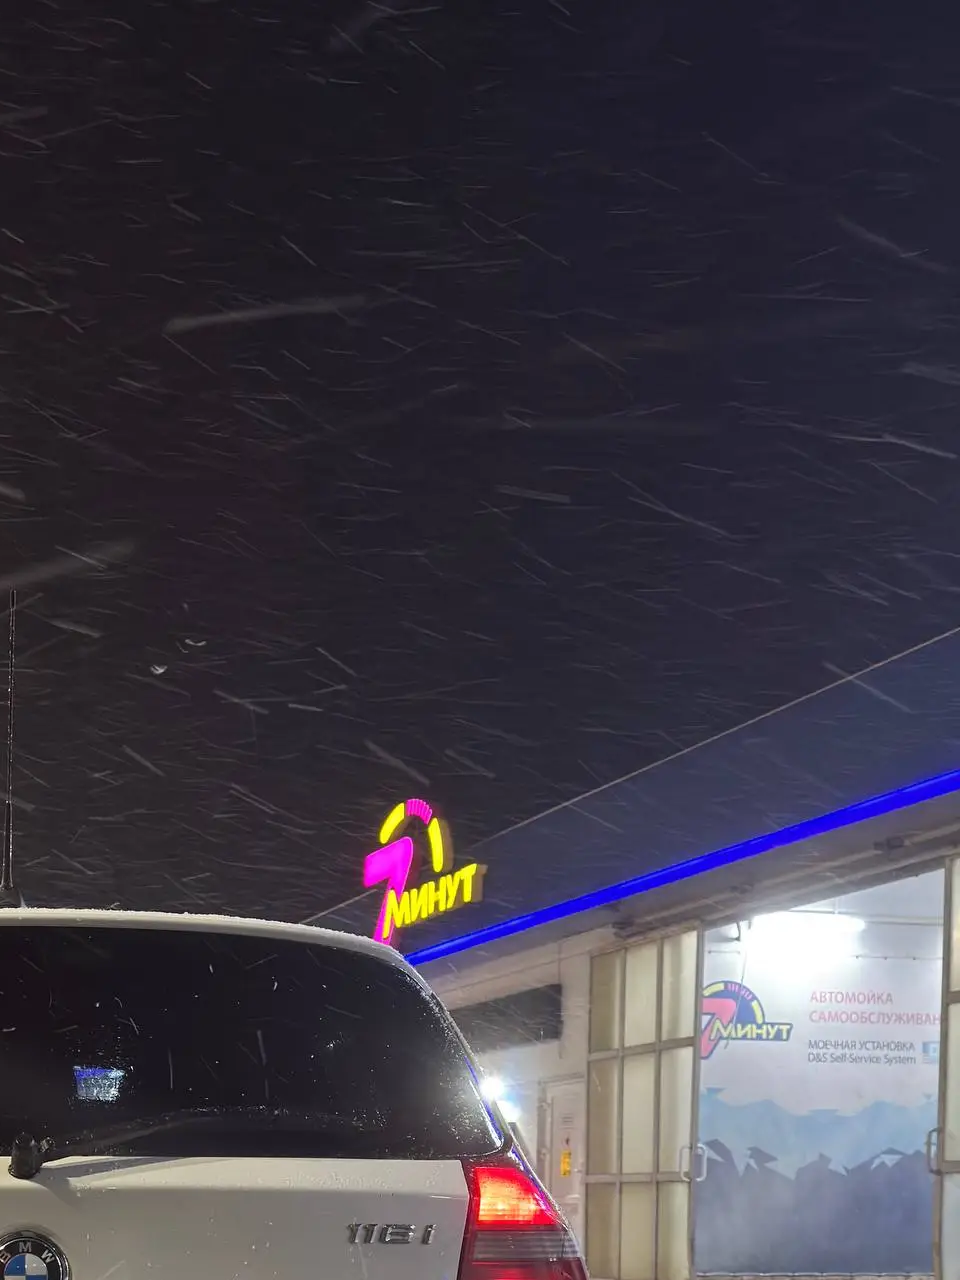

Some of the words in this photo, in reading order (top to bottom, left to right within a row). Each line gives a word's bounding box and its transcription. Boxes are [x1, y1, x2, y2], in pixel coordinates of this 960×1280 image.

[382, 863, 477, 939] МИНУТ
[810, 990, 893, 1004] АВТОМОЙКА
[710, 1018, 791, 1041] МИНУТ
[808, 1039, 857, 1051] МОЕЧНАЯ
[858, 1040, 916, 1052] УСТАНОВКА
[884, 1054, 917, 1066] System
